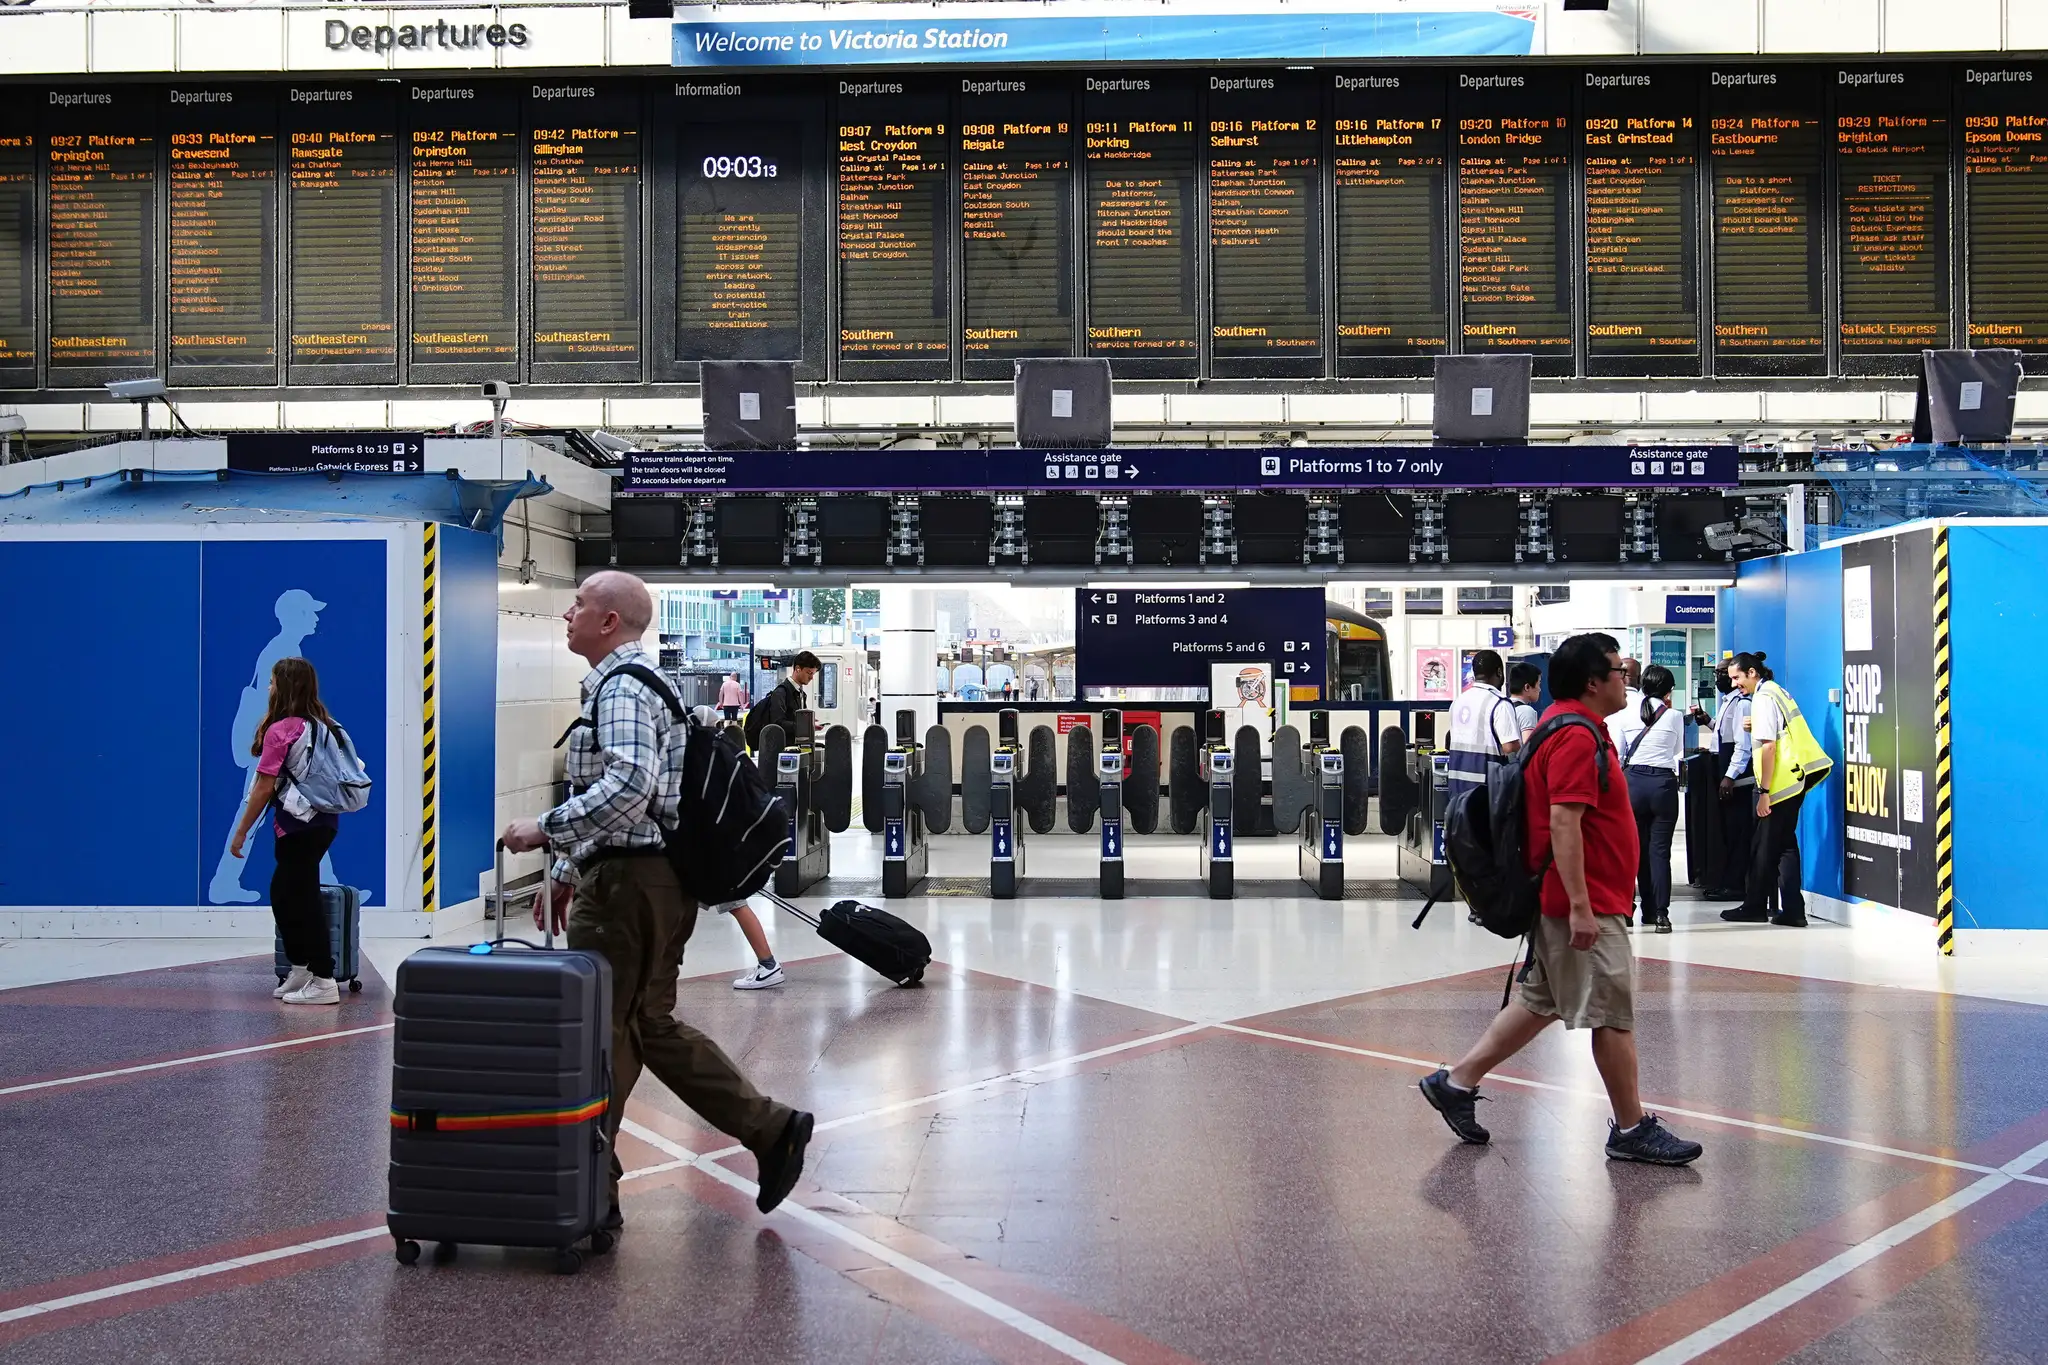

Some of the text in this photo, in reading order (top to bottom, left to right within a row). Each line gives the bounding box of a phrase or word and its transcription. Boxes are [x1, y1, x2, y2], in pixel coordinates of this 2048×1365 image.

[325, 19, 527, 55] Departures
[695, 28, 1008, 51] Welcome to Victoria Station
[1335, 75, 1400, 90] Departures
[1460, 74, 1524, 89] Departures
[1586, 73, 1650, 89] Departures
[1711, 72, 1777, 87] Departures
[1838, 71, 1904, 87] Departures
[1966, 69, 2033, 85] Departures
[675, 83, 741, 96] Information
[839, 82, 903, 97] Departures
[962, 80, 1025, 95] Departures
[1086, 78, 1150, 93] Departures
[1210, 76, 1274, 92] Departures
[49, 91, 112, 107] Departures
[171, 90, 233, 105] Departures
[291, 89, 353, 104] Departures
[412, 87, 474, 102] Departures
[532, 85, 595, 101] Departures
[1087, 121, 1192, 133] 09:11 Platform 11
[1211, 119, 1316, 131] 09:16 Platform 12
[1335, 118, 1441, 130] 09:16 Platform 17
[1460, 118, 1566, 129] 09:20 Platform 10
[1586, 118, 1692, 129] 09:20 Platform 14
[1838, 117, 1927, 128] 09:29 Platform
[534, 128, 618, 140] 09:42 Platform
[840, 125, 944, 136] 09:07 Platform 9
[963, 123, 1068, 135] 09:08 Platform 19
[51, 135, 135, 146] 09:27 Platform
[172, 133, 256, 145] 09:33 Platform
[291, 132, 376, 144] 09:40 Platform
[1087, 137, 1129, 149] Dorking
[1211, 136, 1258, 146] Selhurst
[1335, 135, 1412, 147] Littlehampton
[1460, 134, 1542, 145] London Bridge
[1586, 133, 1673, 144] East Grinstead
[1712, 134, 1778, 144] Eastbourne
[1838, 132, 1888, 143] Brighton
[1966, 131, 2041, 143] Epsom Downs
[413, 146, 466, 158] Orpington
[534, 143, 583, 156] Gillingham
[840, 140, 917, 152] West Croydon
[963, 140, 1005, 152] Reigate
[51, 150, 104, 163] Orpington
[172, 148, 229, 159] Gravesend
[292, 146, 343, 160] Ramsgate
[718, 224, 760, 233] currently
[712, 233, 768, 242] experiencing
[716, 243, 763, 251] widespread
[736, 272, 772, 280] network,
[724, 282, 755, 290] leading
[726, 292, 765, 300] potential
[311, 445, 355, 454] Platforms
[356, 445, 363, 453] 8
[377, 445, 389, 453] 19
[1629, 449, 1708, 462] Assistance gate
[1044, 453, 1122, 466] Assistance gate
[354, 463, 389, 471] Express
[1289, 459, 1443, 476] Platforms 1 to 7 only
[1135, 593, 1225, 604] Platforms 1 and 2
[1675, 606, 1714, 614] Customers
[1135, 614, 1227, 625] Platforms 3 and 4
[1498, 631, 1508, 644] 5
[1173, 642, 1265, 652] Platforms 5 and 6
[1845, 664, 1883, 714] SHOP.
[1846, 715, 1871, 764] EAT.
[1846, 764, 1888, 818] ENJOY.
